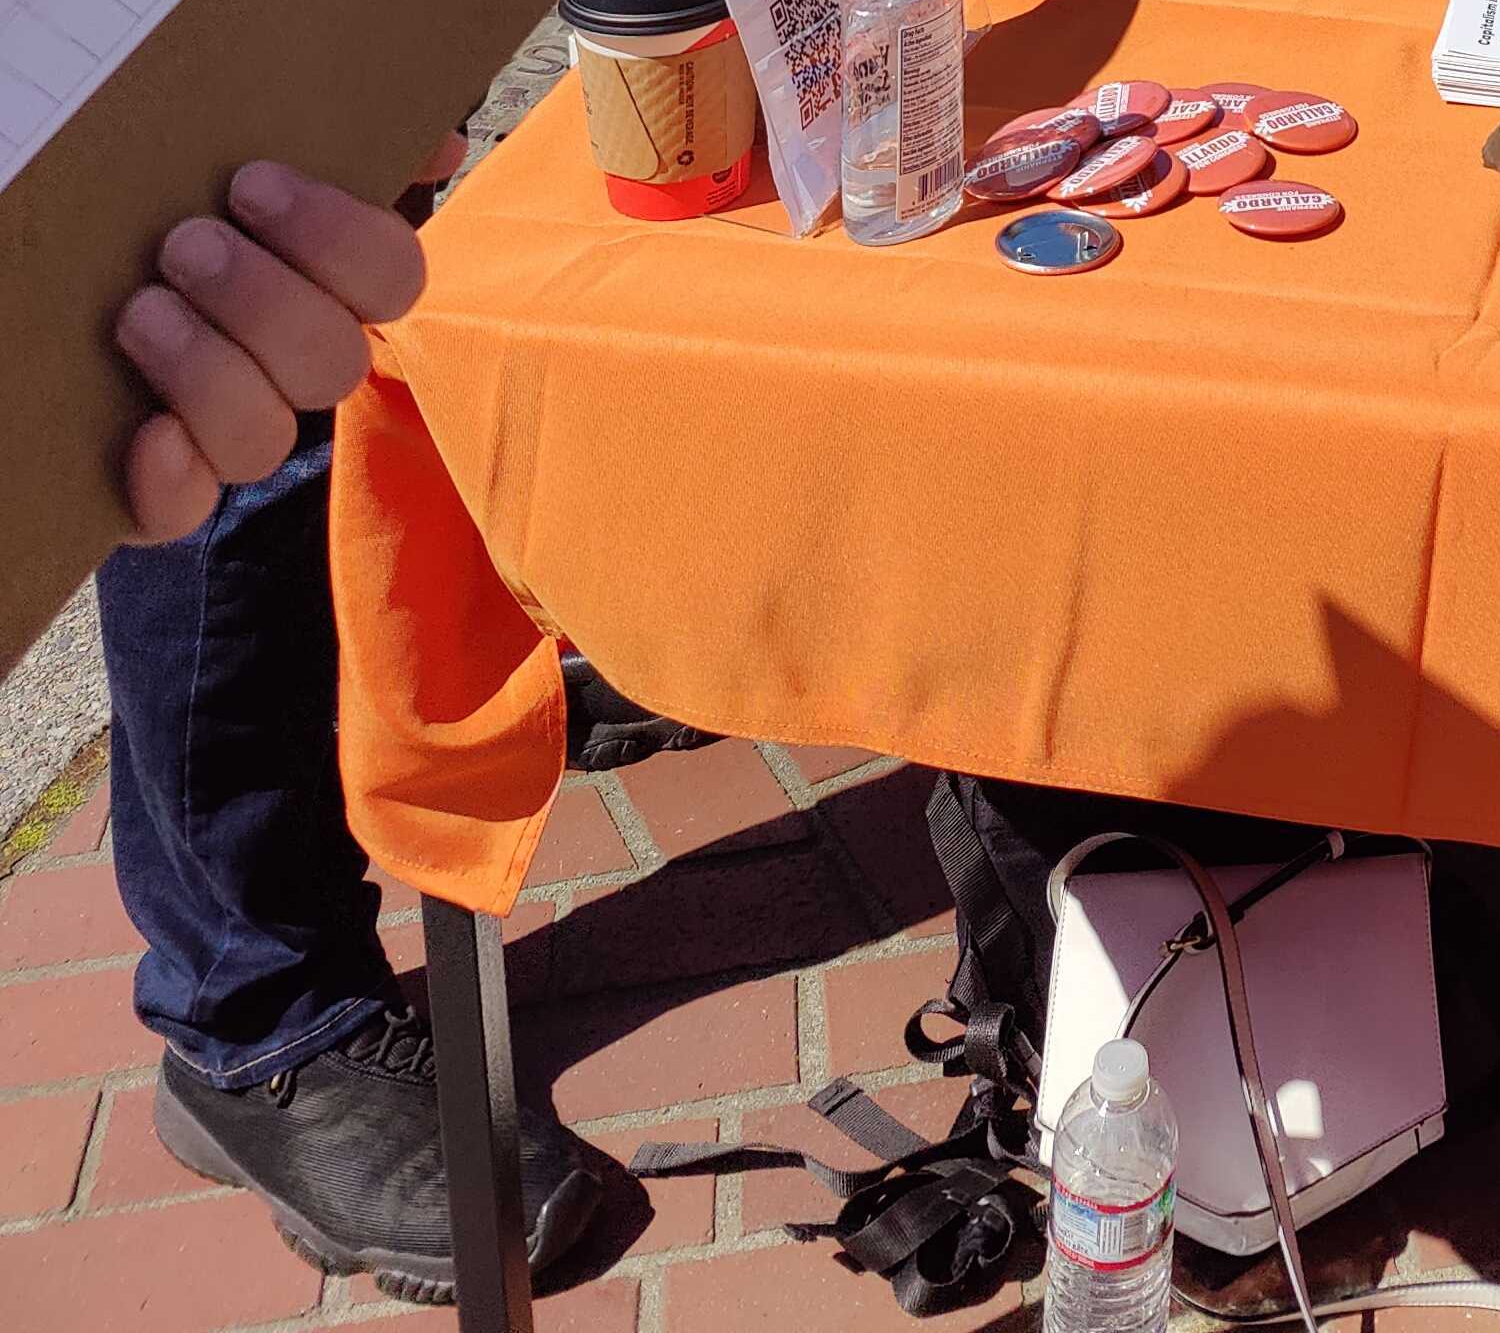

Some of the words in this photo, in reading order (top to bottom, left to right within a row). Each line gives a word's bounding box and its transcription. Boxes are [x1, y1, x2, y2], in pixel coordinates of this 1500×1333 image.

[1478, 4, 1496, 46] Capitalism
[1266, 104, 1334, 129] GALLARDO
[977, 142, 1062, 178] GALLARDO
[1185, 134, 1240, 163] LLARDO
[1236, 196, 1322, 209] GALLARDO
